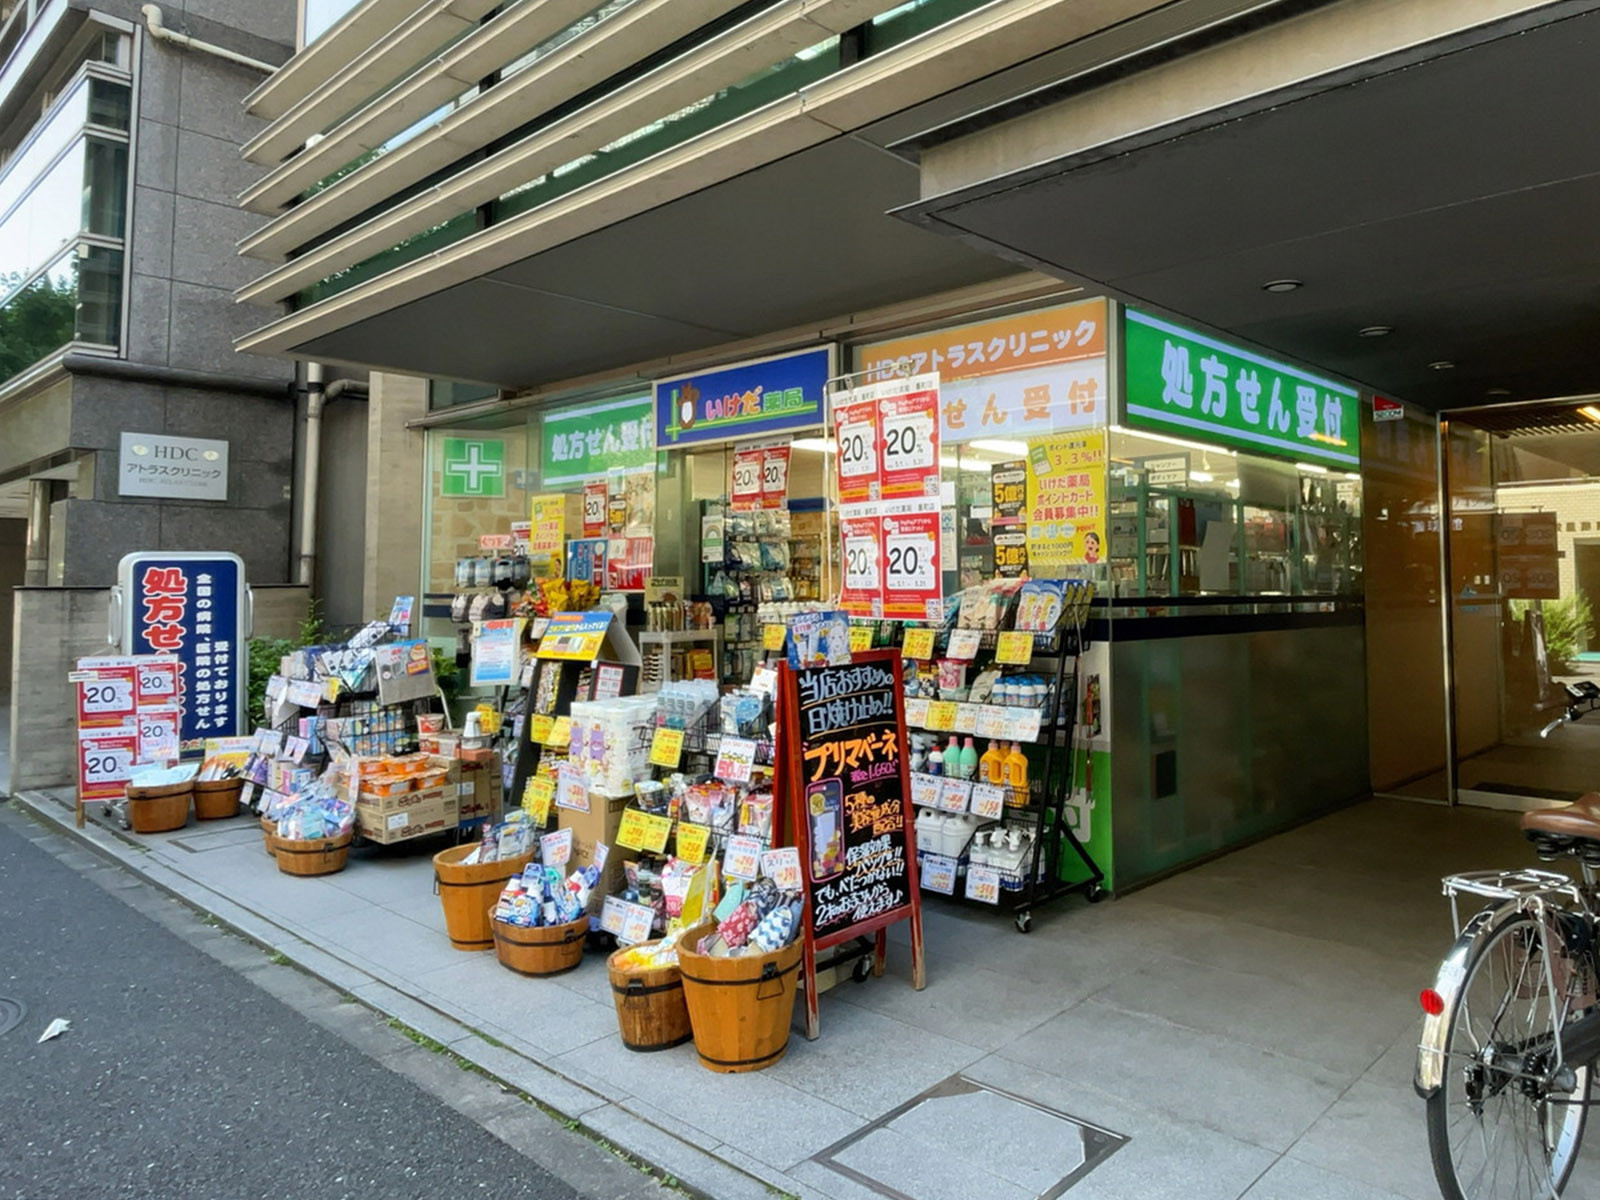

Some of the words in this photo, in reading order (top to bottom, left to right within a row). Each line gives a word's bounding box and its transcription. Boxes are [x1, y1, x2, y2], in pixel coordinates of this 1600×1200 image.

[706, 385, 804, 421] いけだ薬局
[1162, 339, 1342, 443] 処方せん受付
[127, 463, 222, 479] アトラスクリニック
[154, 445, 199, 461] HDC
[214, 641, 229, 727] 受付ております
[799, 666, 895, 705] 当店おすすめの
[804, 729, 898, 781] プリマベーネ
